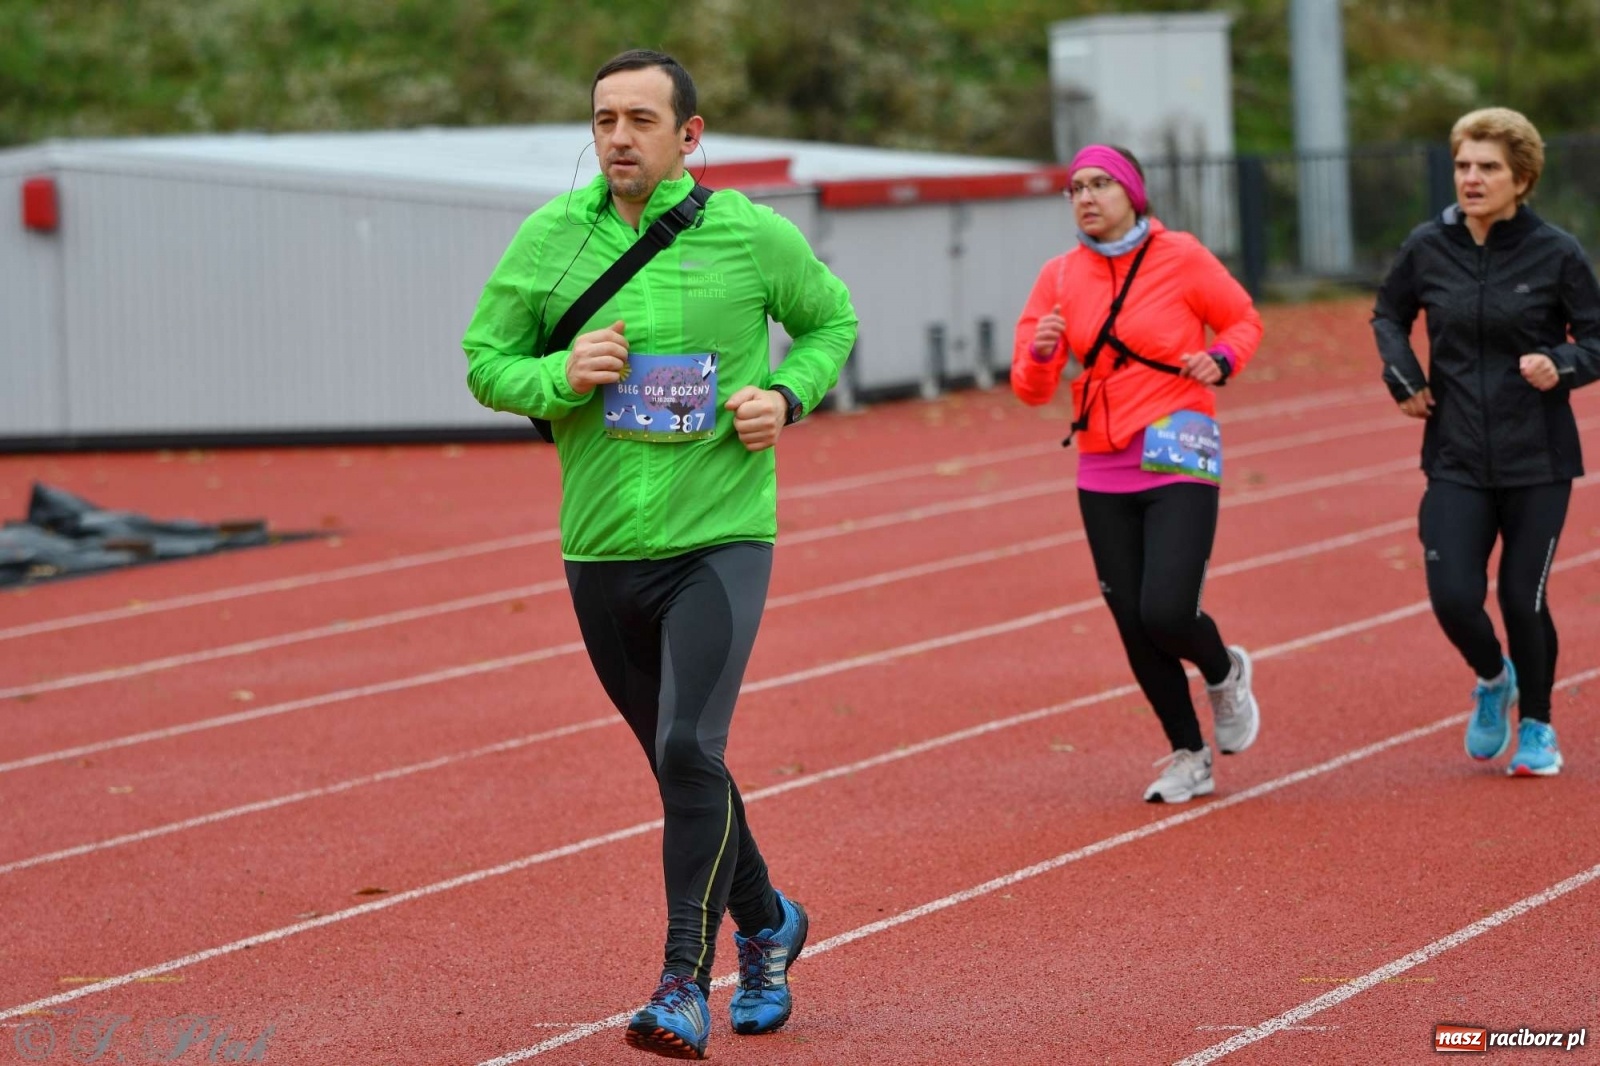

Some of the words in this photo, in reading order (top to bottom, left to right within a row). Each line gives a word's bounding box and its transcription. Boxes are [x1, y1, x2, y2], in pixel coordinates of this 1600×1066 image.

[688, 288, 727, 298] ATHLETIC
[618, 384, 639, 395] BIEG
[645, 386, 664, 396] DLA
[670, 384, 710, 396] BOŻENY
[669, 413, 705, 433] 287
